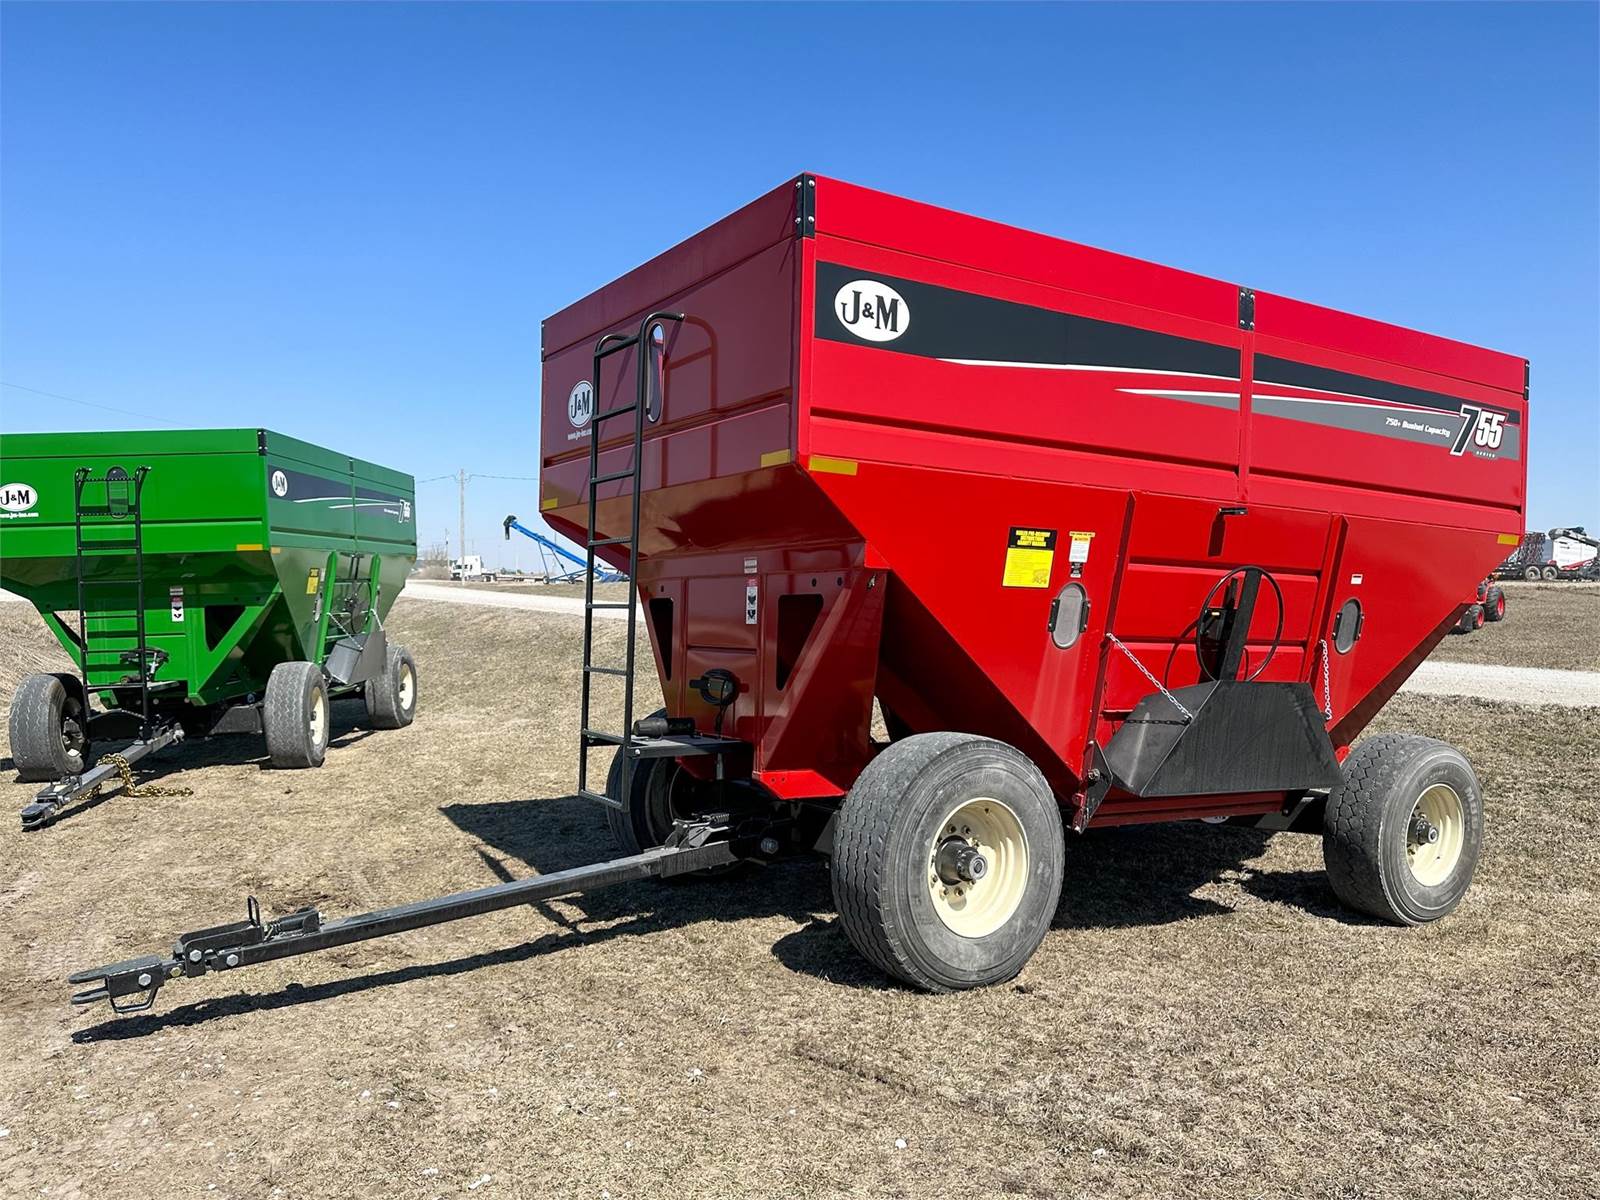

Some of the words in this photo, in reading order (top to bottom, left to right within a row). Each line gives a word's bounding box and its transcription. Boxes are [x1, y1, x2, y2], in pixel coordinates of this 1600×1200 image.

[841, 290, 900, 333] J&M
[570, 390, 591, 419] J&M
[1385, 417, 1401, 427] 750+
[1402, 420, 1424, 432] Bushel
[1424, 424, 1451, 438] Capacity
[1450, 404, 1506, 456] 755
[0, 490, 30, 506] J&M
